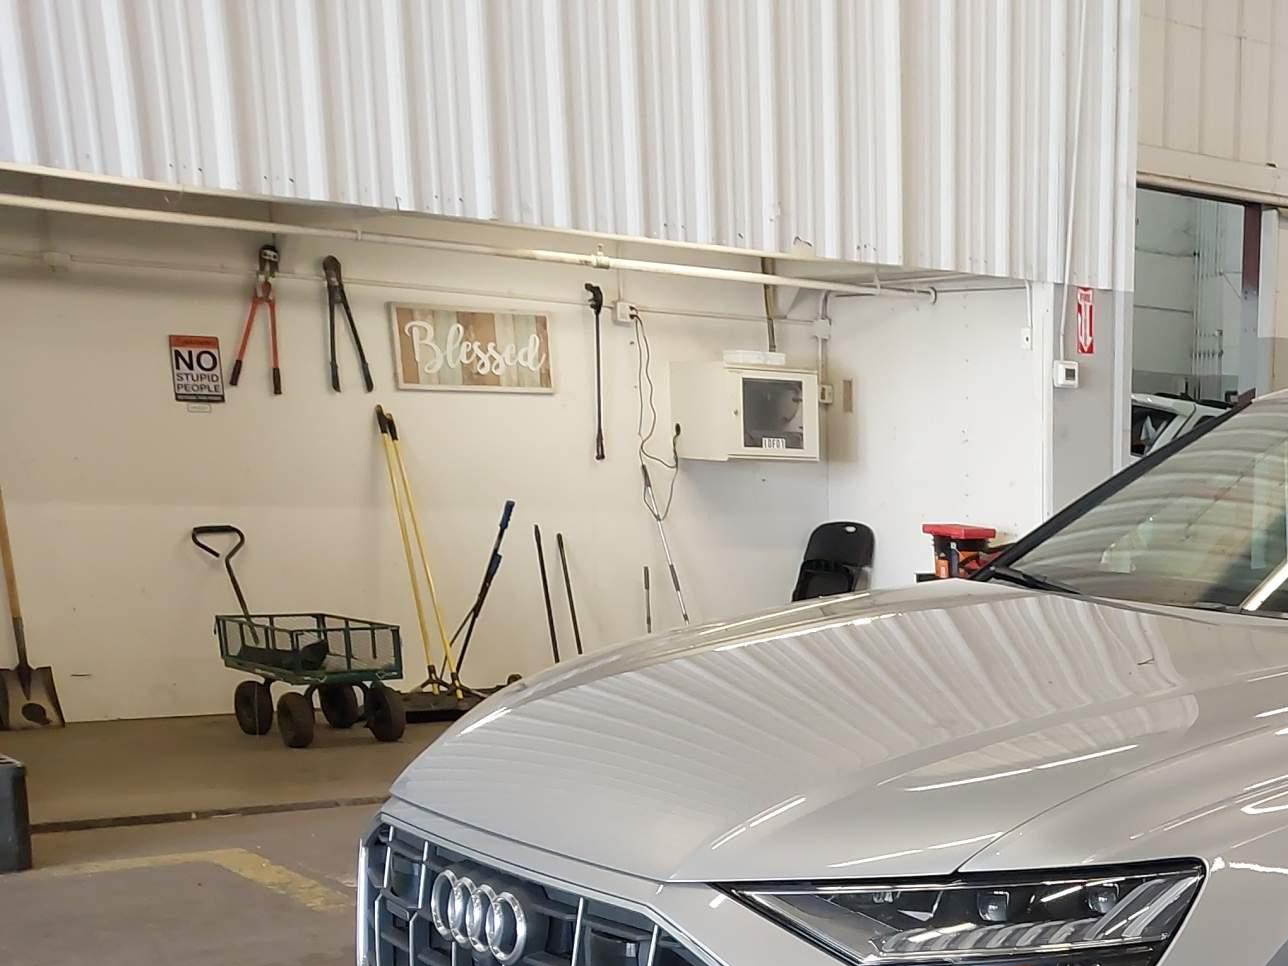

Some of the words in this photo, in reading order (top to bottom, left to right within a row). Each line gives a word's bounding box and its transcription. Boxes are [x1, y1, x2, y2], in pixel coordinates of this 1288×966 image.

[404, 320, 546, 375] Blessed
[174, 349, 218, 371] NO
[176, 372, 220, 383] STUPID
[177, 383, 221, 393] PEOPLE
